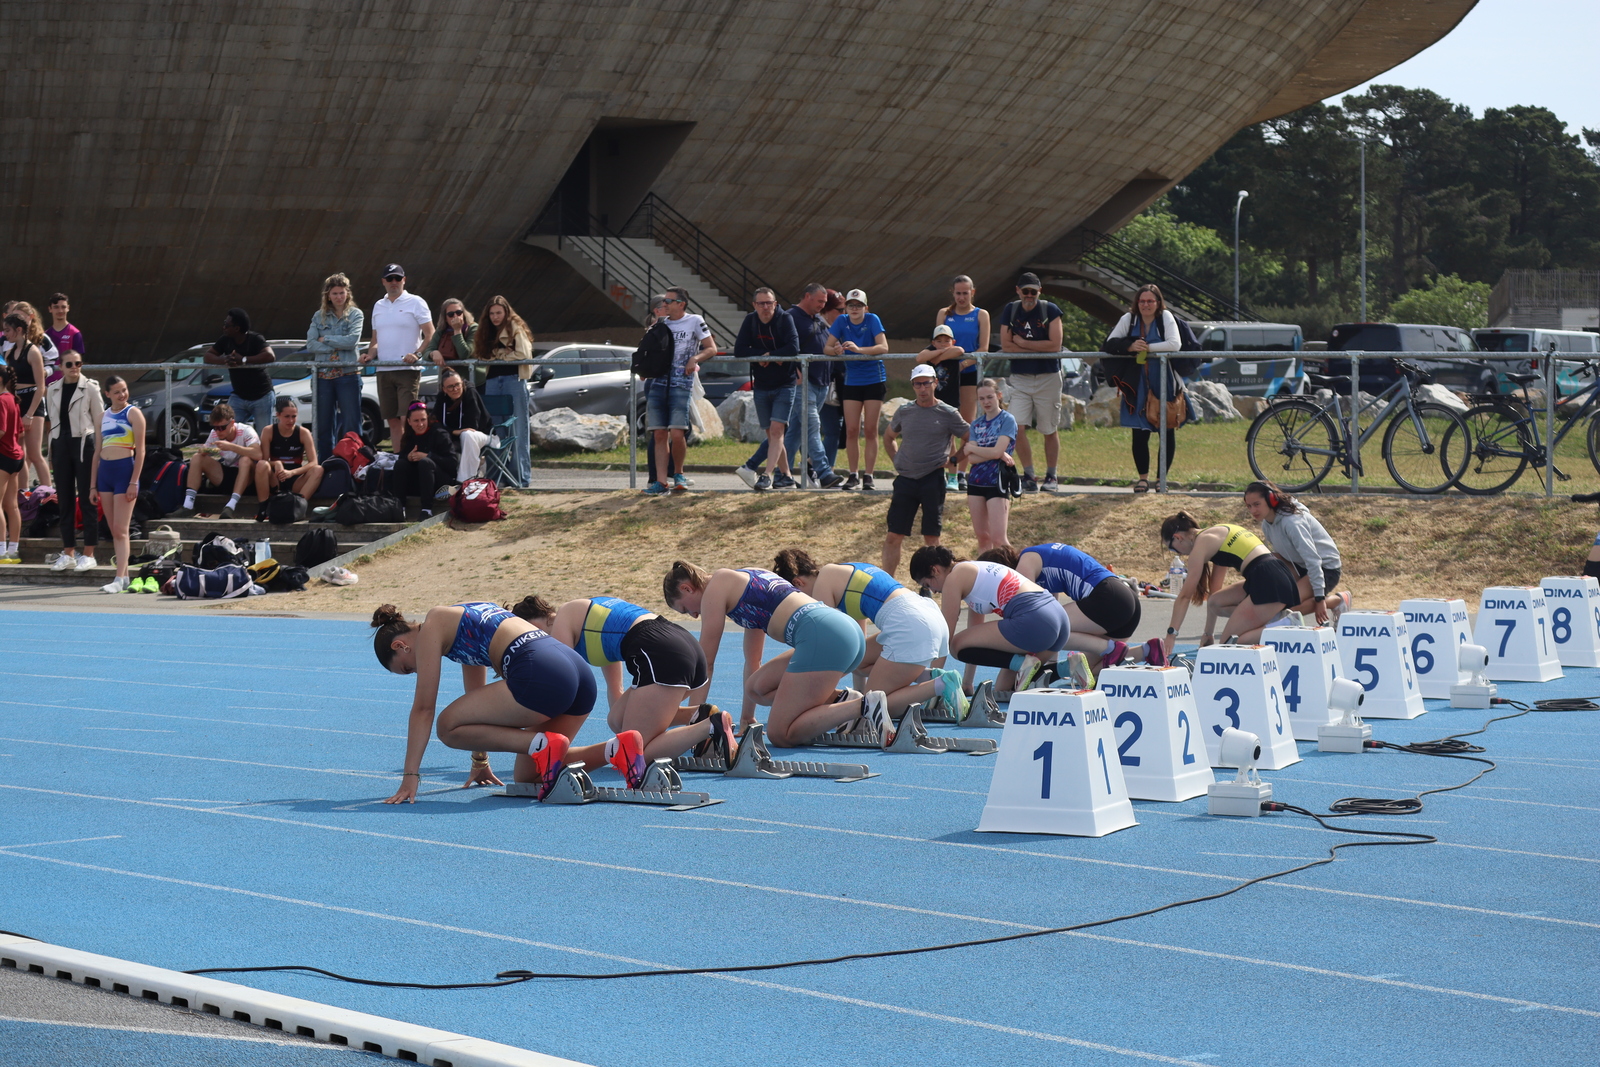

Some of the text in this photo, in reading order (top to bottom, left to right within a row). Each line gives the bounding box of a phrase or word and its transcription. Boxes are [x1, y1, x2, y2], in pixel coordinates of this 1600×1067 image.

[1543, 588, 1583, 599] DIMA
[792, 603, 817, 621] PRO
[1485, 600, 1527, 609] DIMA
[1404, 613, 1446, 623] DIMA
[1452, 611, 1467, 623] DIMA
[1552, 607, 1571, 644] 8
[1342, 626, 1391, 637] DIMA
[1495, 619, 1516, 657] 7
[1538, 618, 1548, 656] 7
[510, 631, 538, 653] NIKE
[1265, 641, 1315, 654] DIMA
[1321, 640, 1337, 654] DIMA
[1411, 633, 1435, 674] 6
[1200, 662, 1255, 675] DIMA
[1262, 660, 1278, 675] DIMA
[1352, 648, 1379, 692] 5
[1402, 647, 1413, 690] 5
[1101, 684, 1158, 698] DIMA
[1167, 684, 1190, 698] DIMA
[1282, 665, 1301, 713] 4
[1013, 711, 1076, 726] DIMA
[1084, 707, 1108, 725] DIMA
[1212, 688, 1240, 737] 3
[1271, 686, 1283, 735] 3
[1114, 711, 1142, 767] 2
[1178, 711, 1195, 765] 2
[1033, 741, 1053, 799] 1
[1098, 738, 1111, 794] 1
